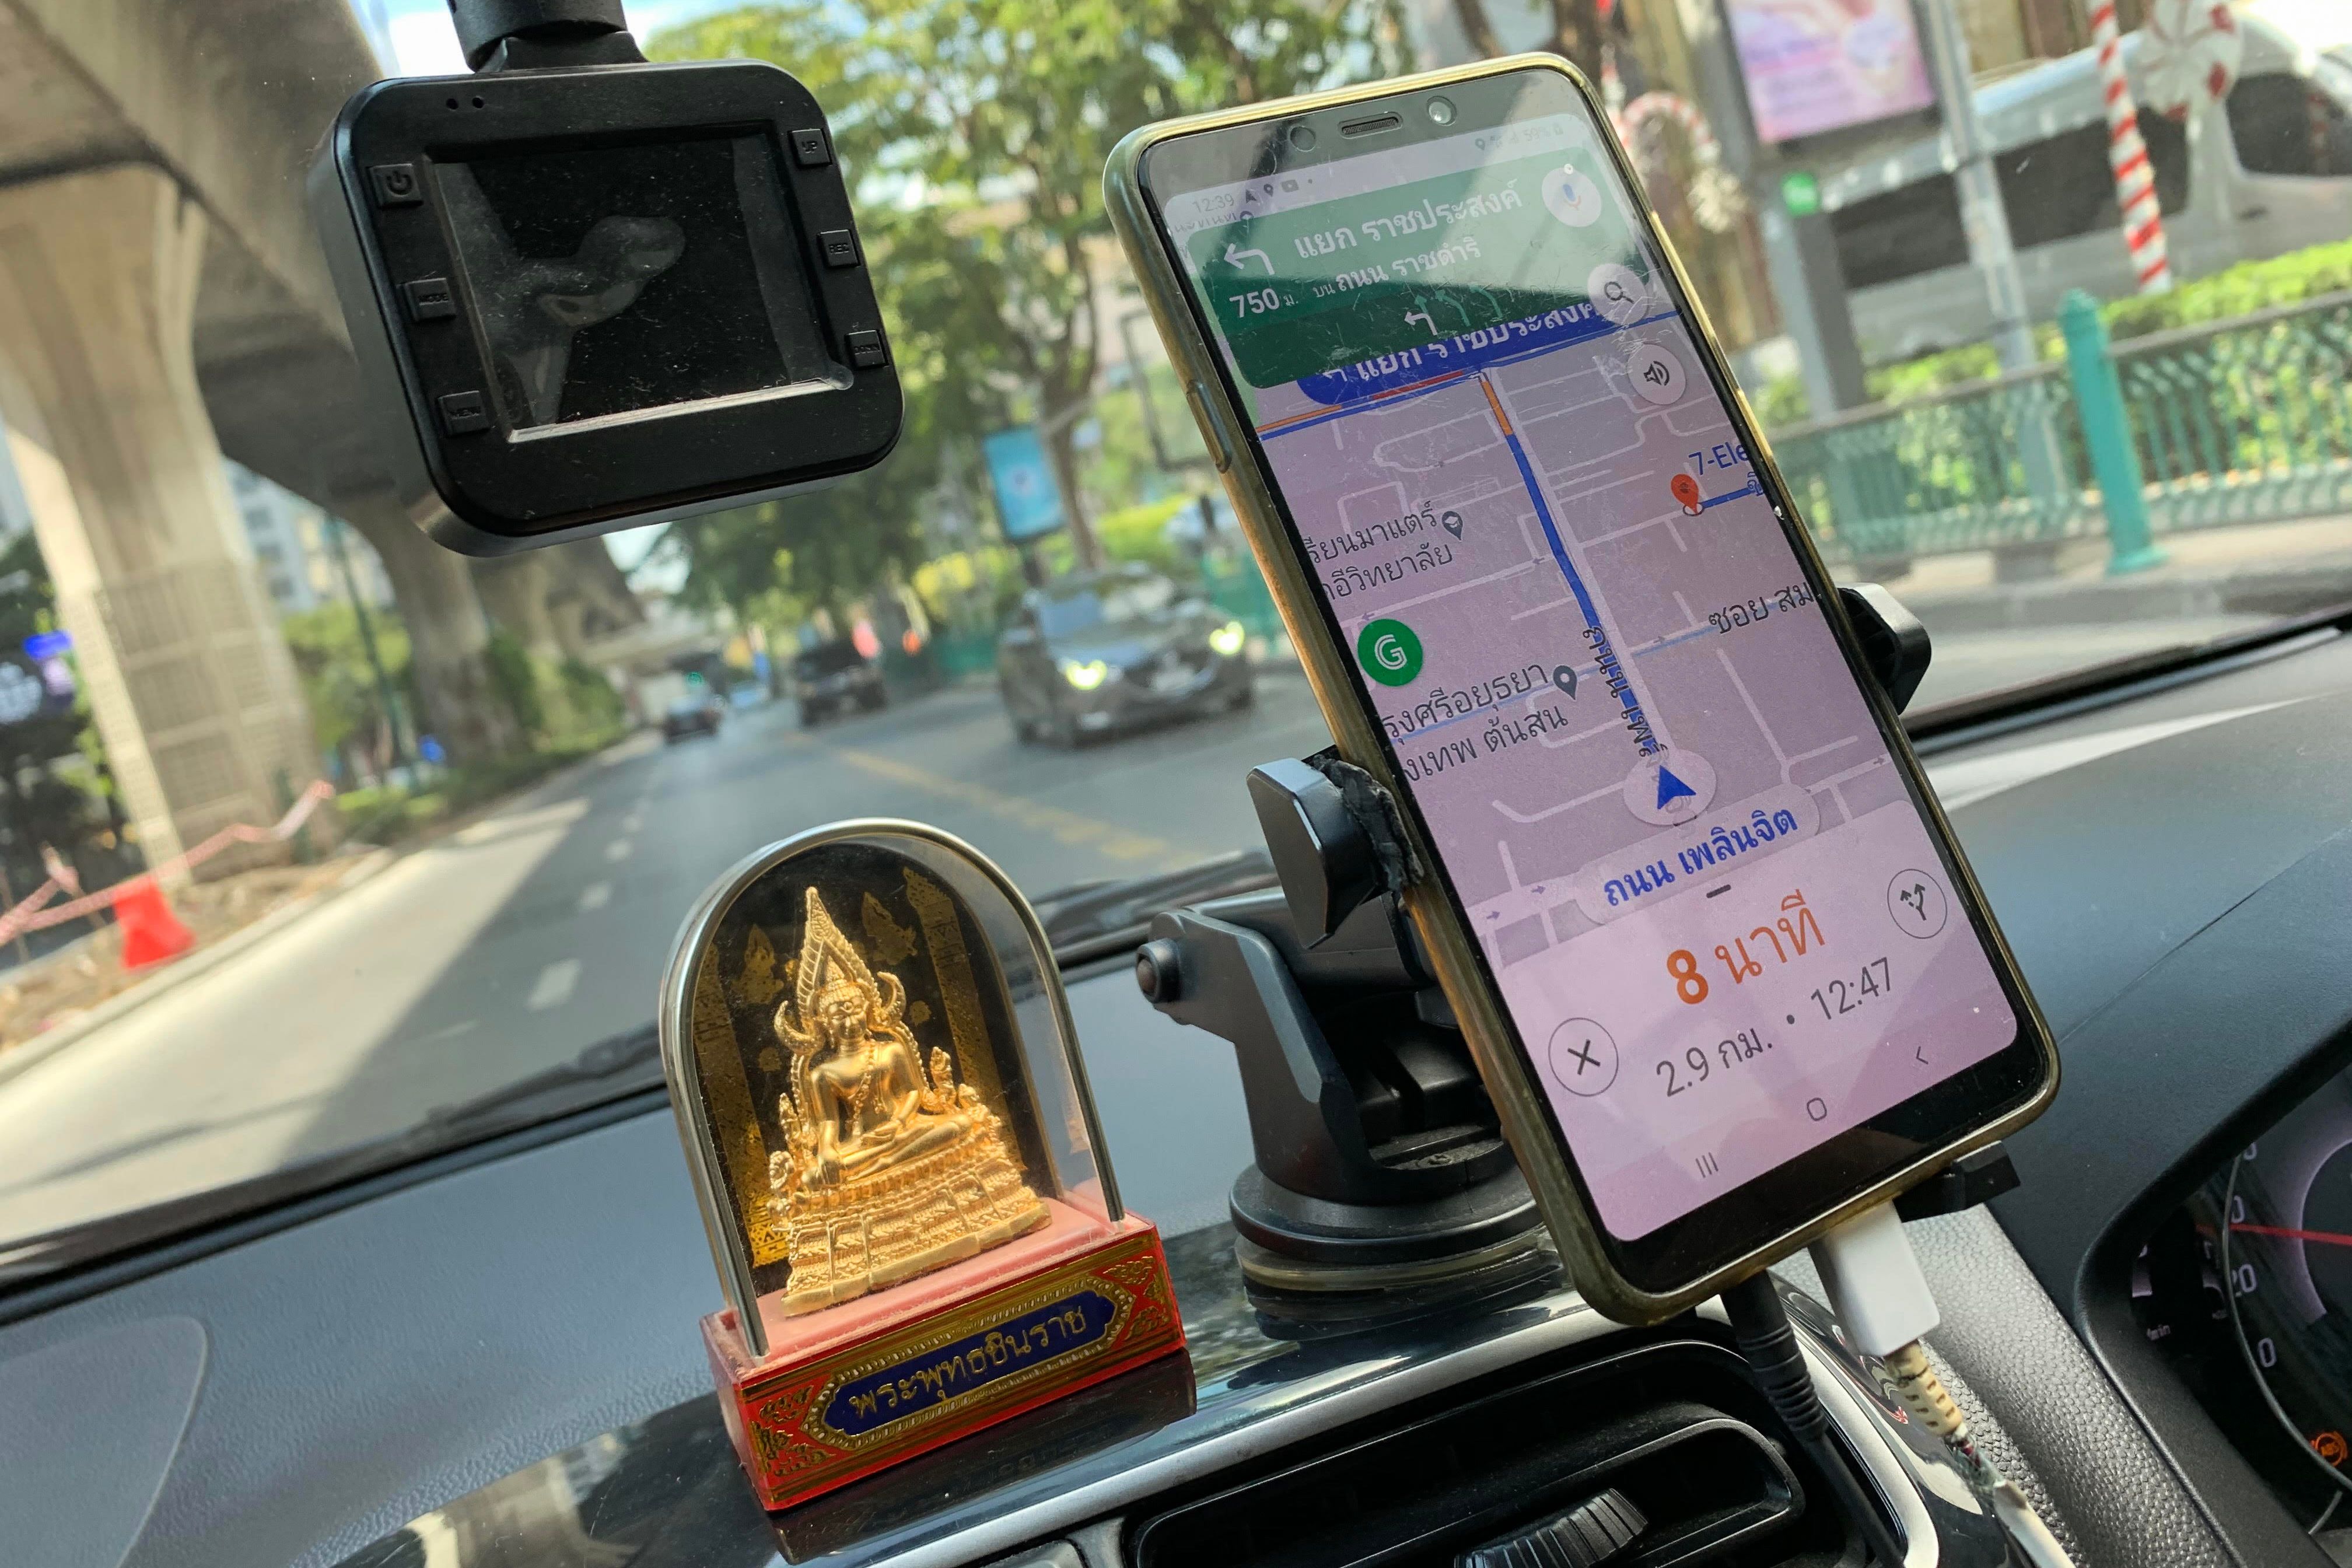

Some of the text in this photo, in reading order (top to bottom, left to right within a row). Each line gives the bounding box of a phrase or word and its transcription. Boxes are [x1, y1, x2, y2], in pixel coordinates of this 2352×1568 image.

[802, 140, 818, 153] UP
[1192, 194, 1235, 213] 12:39
[1294, 178, 1523, 258] แยก ราชประสงค์
[828, 243, 849, 255] REC
[1312, 236, 1482, 298] บน ถนน ราชดำริ
[1229, 288, 1299, 318] 750 ม.
[1708, 596, 1769, 635] ซอย
[1374, 634, 1408, 670] G
[1583, 626, 1629, 698] ถนน
[1404, 705, 1569, 781] งเทพ ต้นสน
[1603, 808, 1798, 907] ถนน เพลินจิต
[1666, 888, 1826, 1005] 8 นาที
[1656, 957, 1892, 1097] 2.9 กม. 12:47
[849, 1305, 1087, 1419] พระพุทธชินราช
[2258, 1337, 2276, 1368] 0
